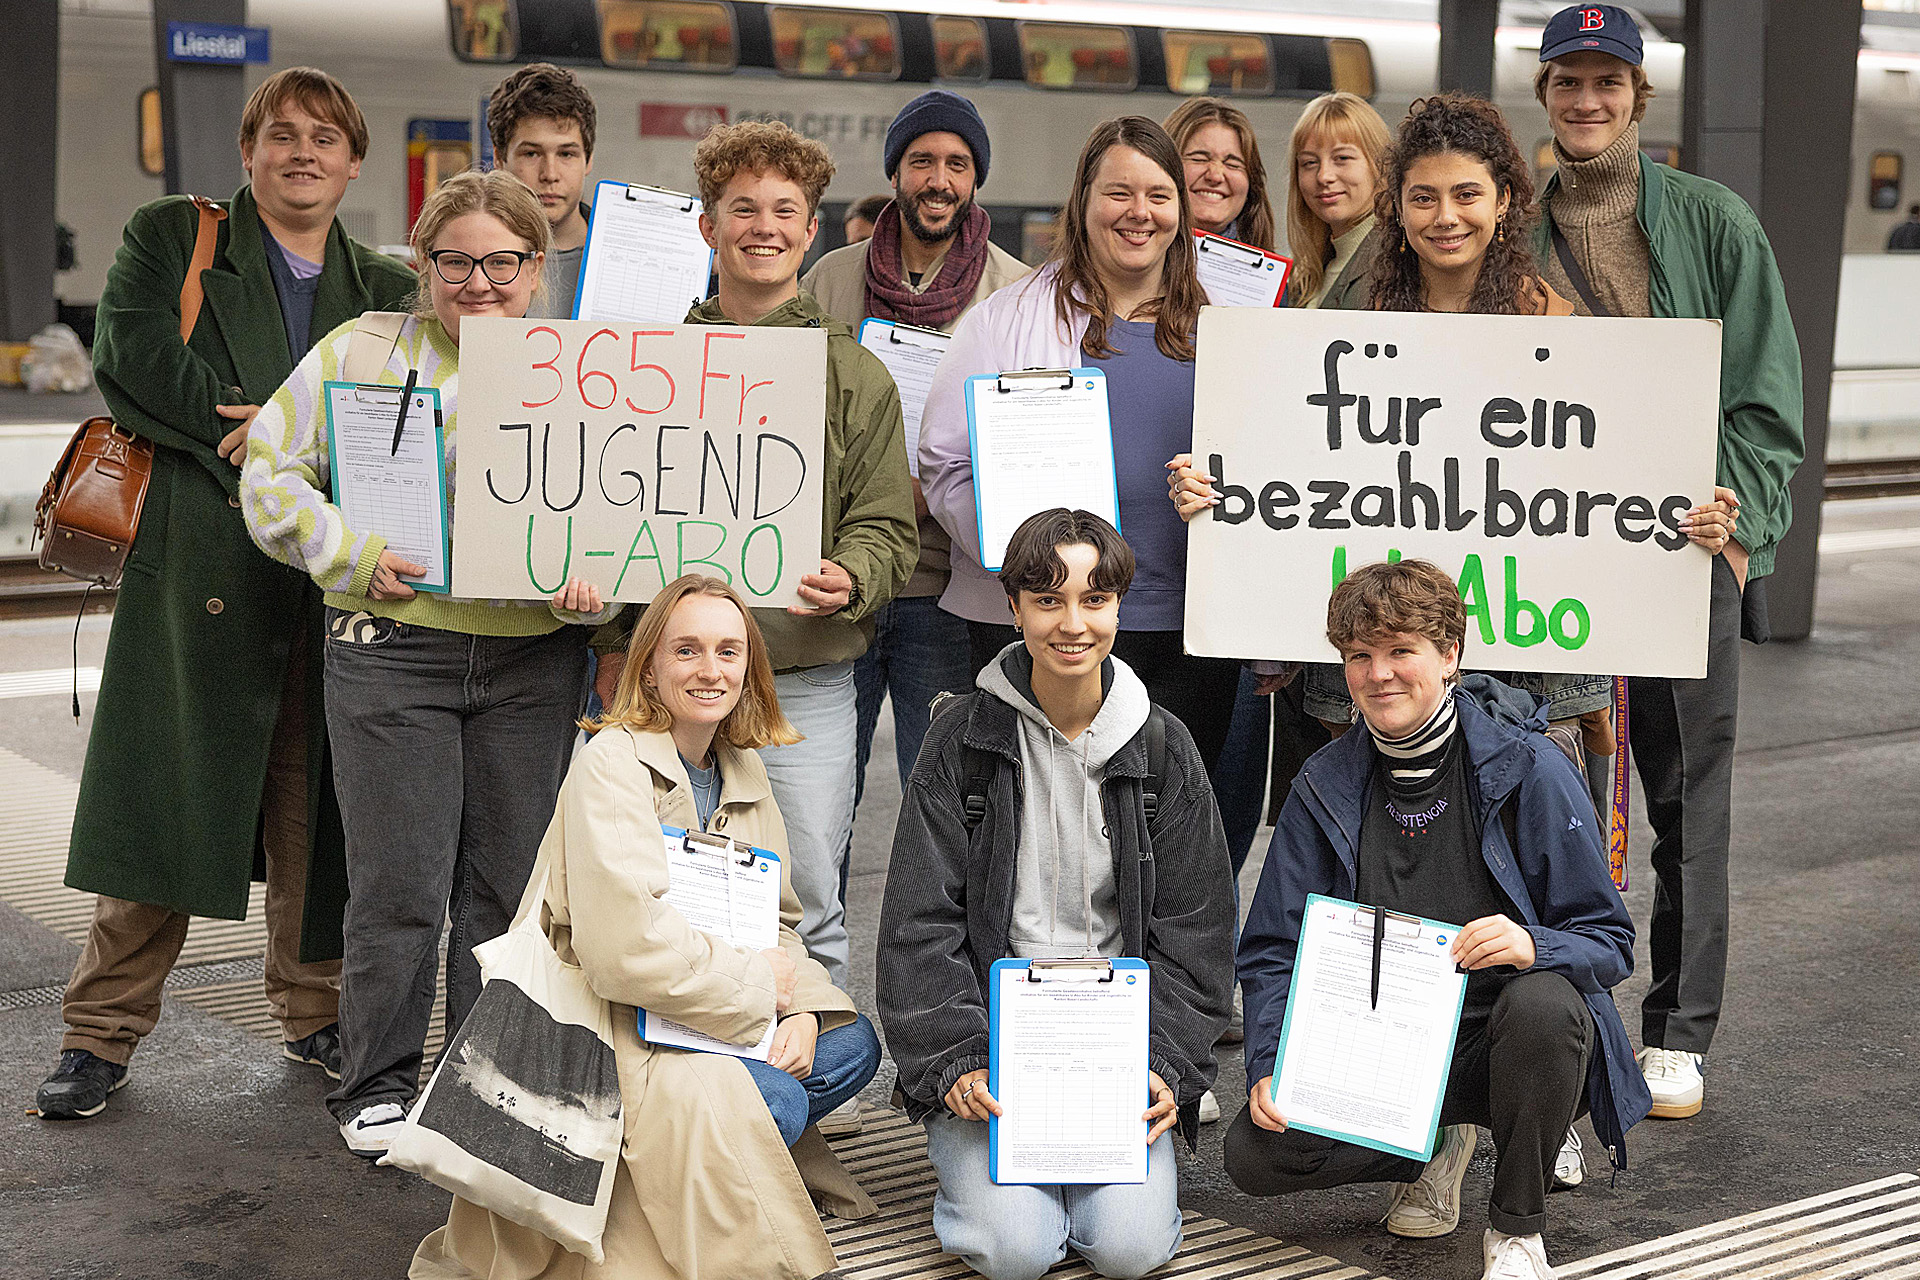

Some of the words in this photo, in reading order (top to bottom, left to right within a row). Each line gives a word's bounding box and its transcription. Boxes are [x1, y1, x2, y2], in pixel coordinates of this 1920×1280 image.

[173, 30, 247, 59] Liestal
[1578, 8, 1605, 31] B
[522, 326, 676, 415] 365
[698, 332, 775, 426] Fr.
[1306, 340, 1442, 450] für
[1480, 347, 1596, 449] ein
[486, 421, 807, 520] JUGEND
[1208, 451, 1692, 551] bezahlbares
[526, 514, 784, 597] U-ABO
[1617, 713, 1625, 742] HEISST
[1616, 745, 1625, 804] WIDERSTAND
